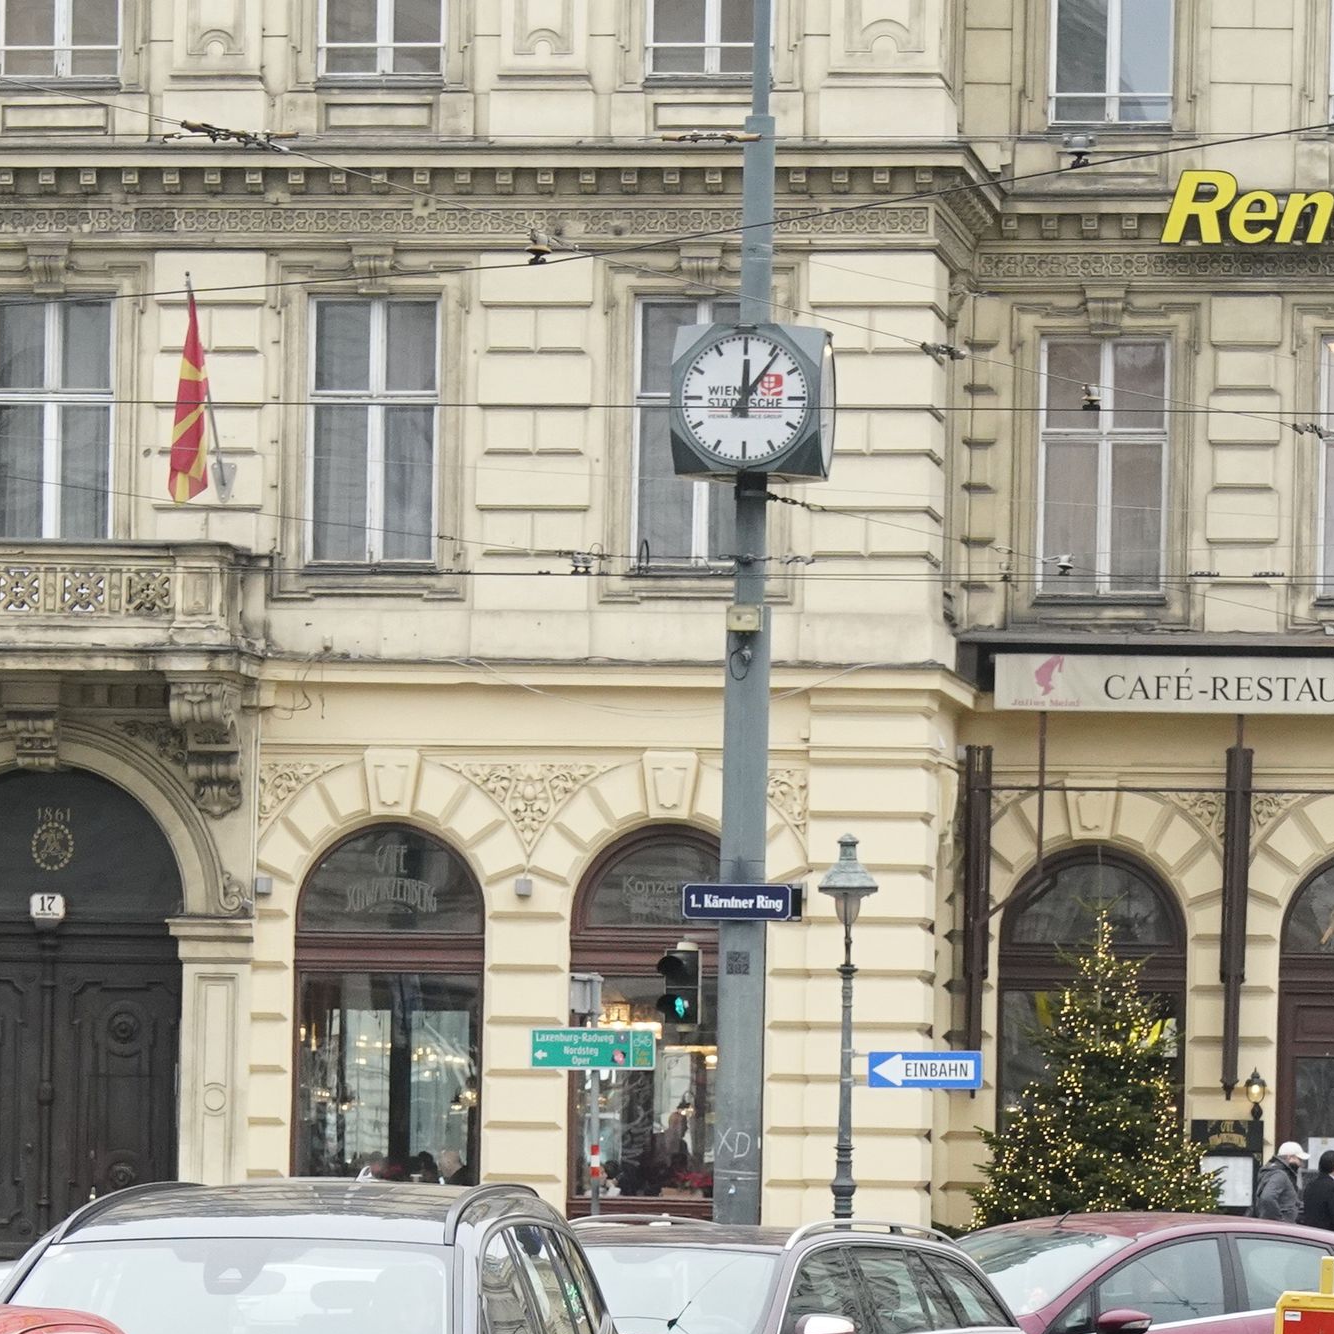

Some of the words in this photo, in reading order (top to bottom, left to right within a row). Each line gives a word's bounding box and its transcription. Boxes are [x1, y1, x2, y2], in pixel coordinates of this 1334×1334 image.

[708, 385, 758, 396] WIENR
[37, 807, 71, 822] 1861
[622, 875, 680, 894] Konzer
[40, 895, 56, 911] 17
[689, 894, 702, 908] 1.
[704, 893, 755, 909] Kärntner
[756, 895, 784, 912] Ring
[535, 1032, 615, 1044] Laxenburg-Radweg
[563, 1046, 599, 1057] Nordsteg
[571, 1056, 591, 1066] Oper
[903, 1060, 969, 1079] EINBAHN
